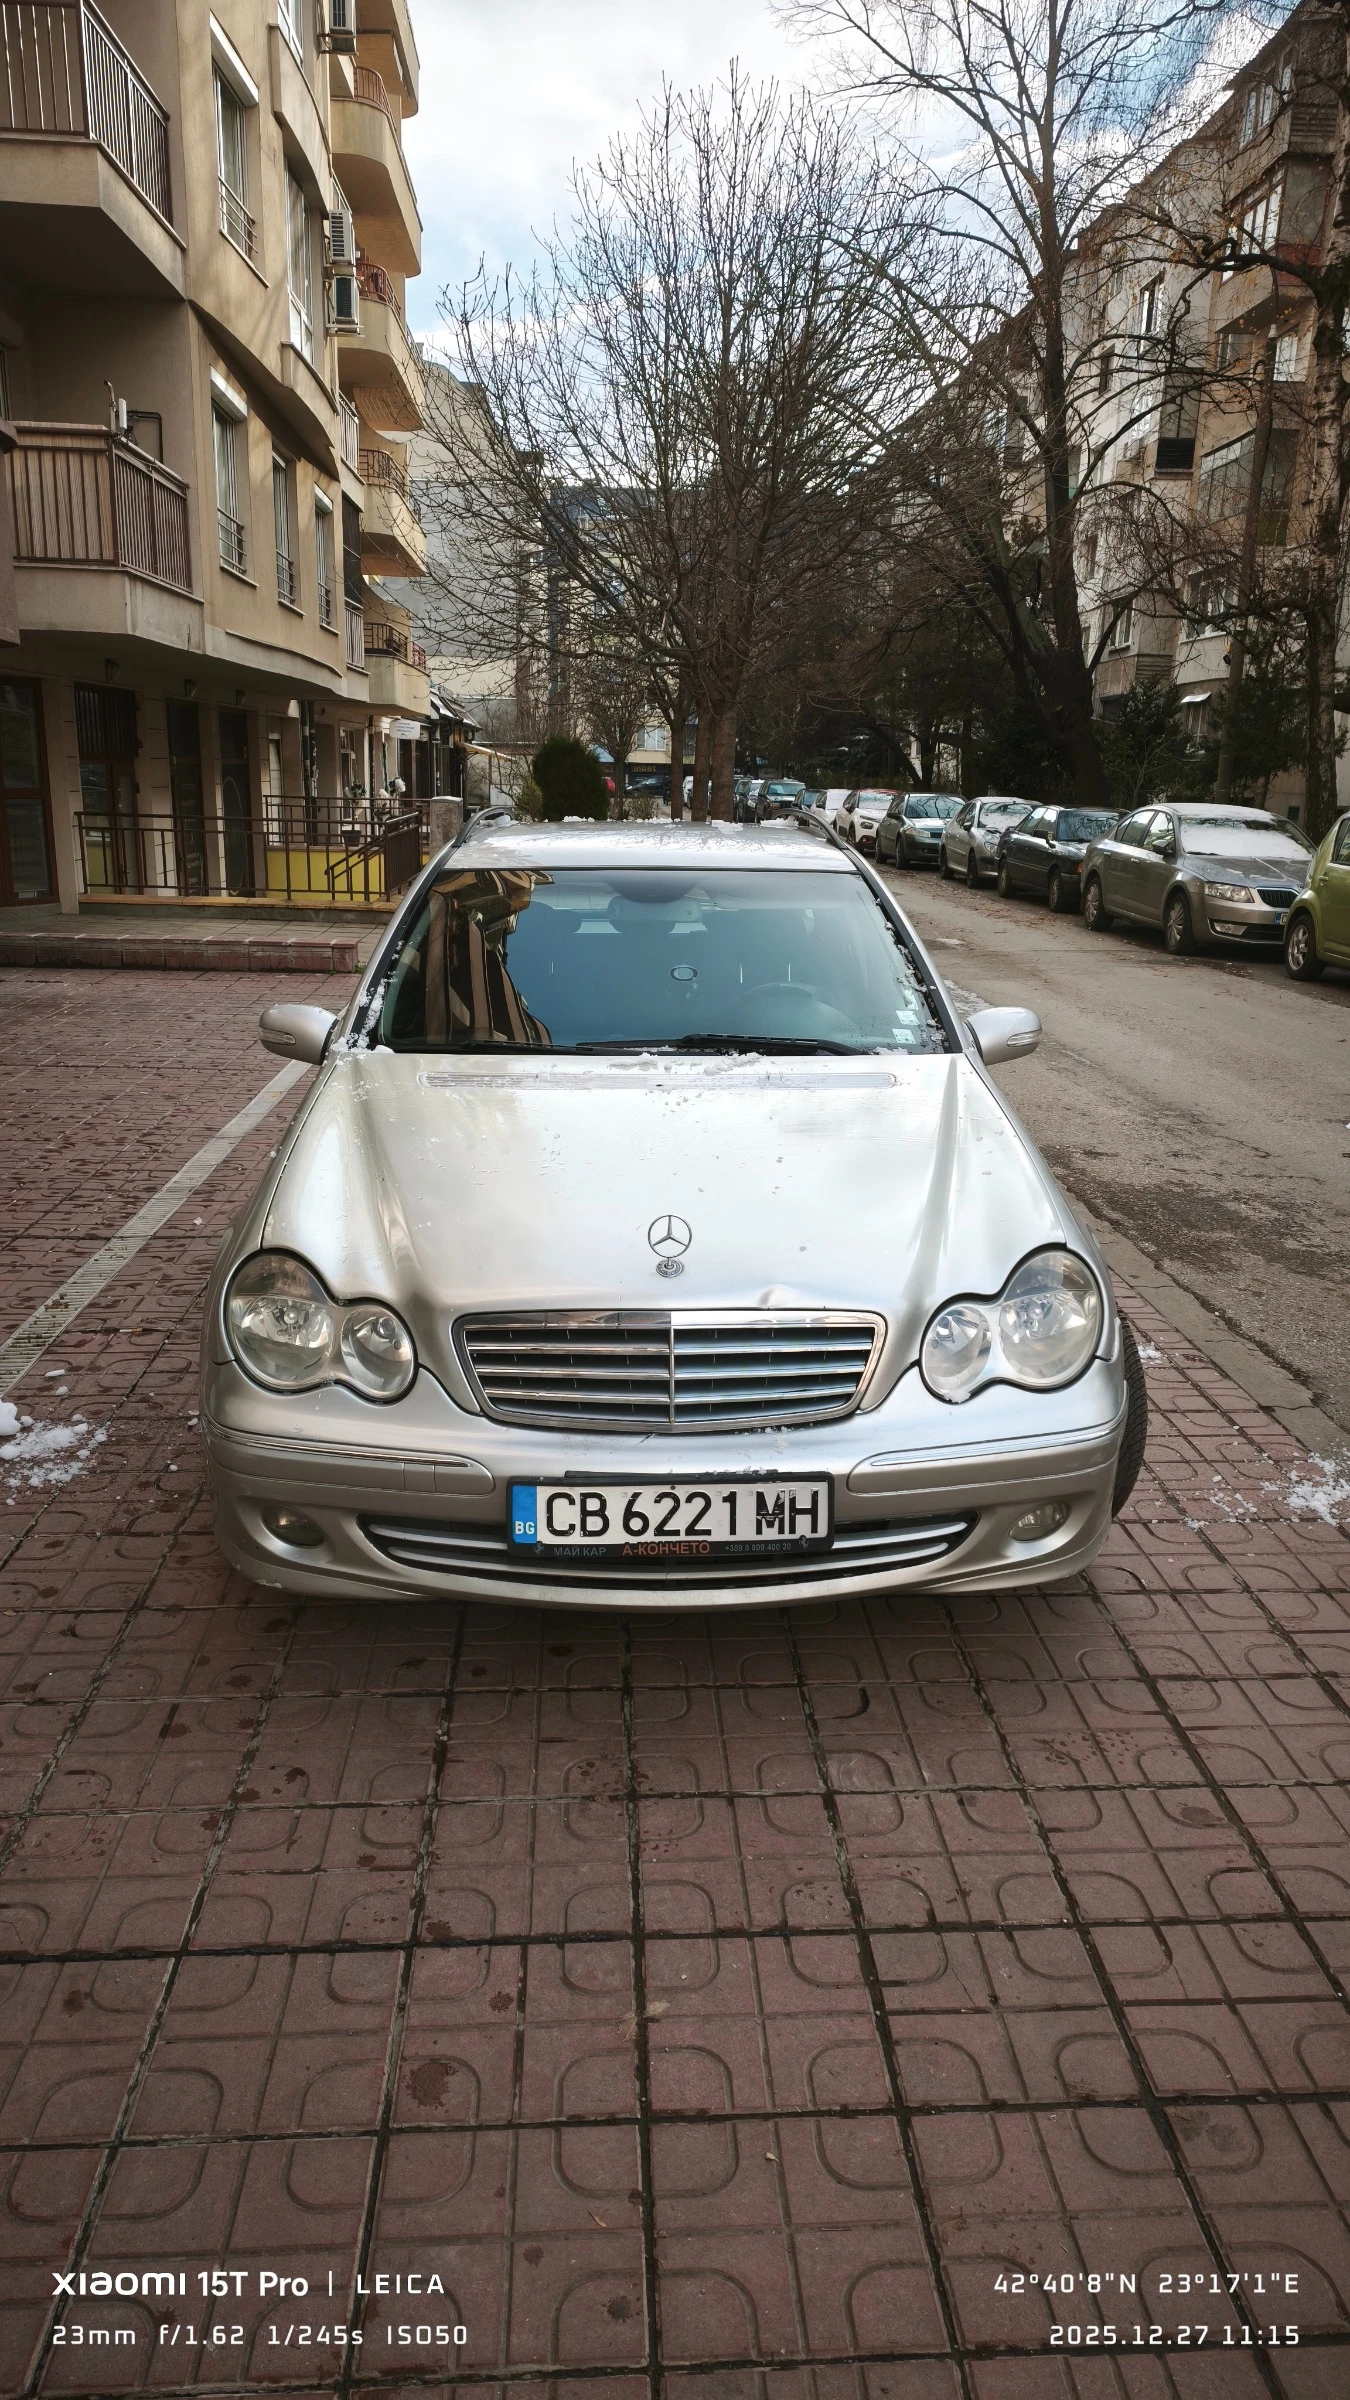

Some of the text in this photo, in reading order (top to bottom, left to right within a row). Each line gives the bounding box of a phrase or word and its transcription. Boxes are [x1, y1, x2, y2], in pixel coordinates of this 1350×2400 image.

[633, 764, 657, 773] inbet
[546, 1489, 819, 1538] CB 6221 MH
[514, 1521, 536, 1536] BG
[582, 1546, 607, 1557] КАР
[622, 1541, 711, 1557] А-КОНЧЕТО
[724, 1544, 743, 1552] +359
[782, 1542, 792, 1550] 20
